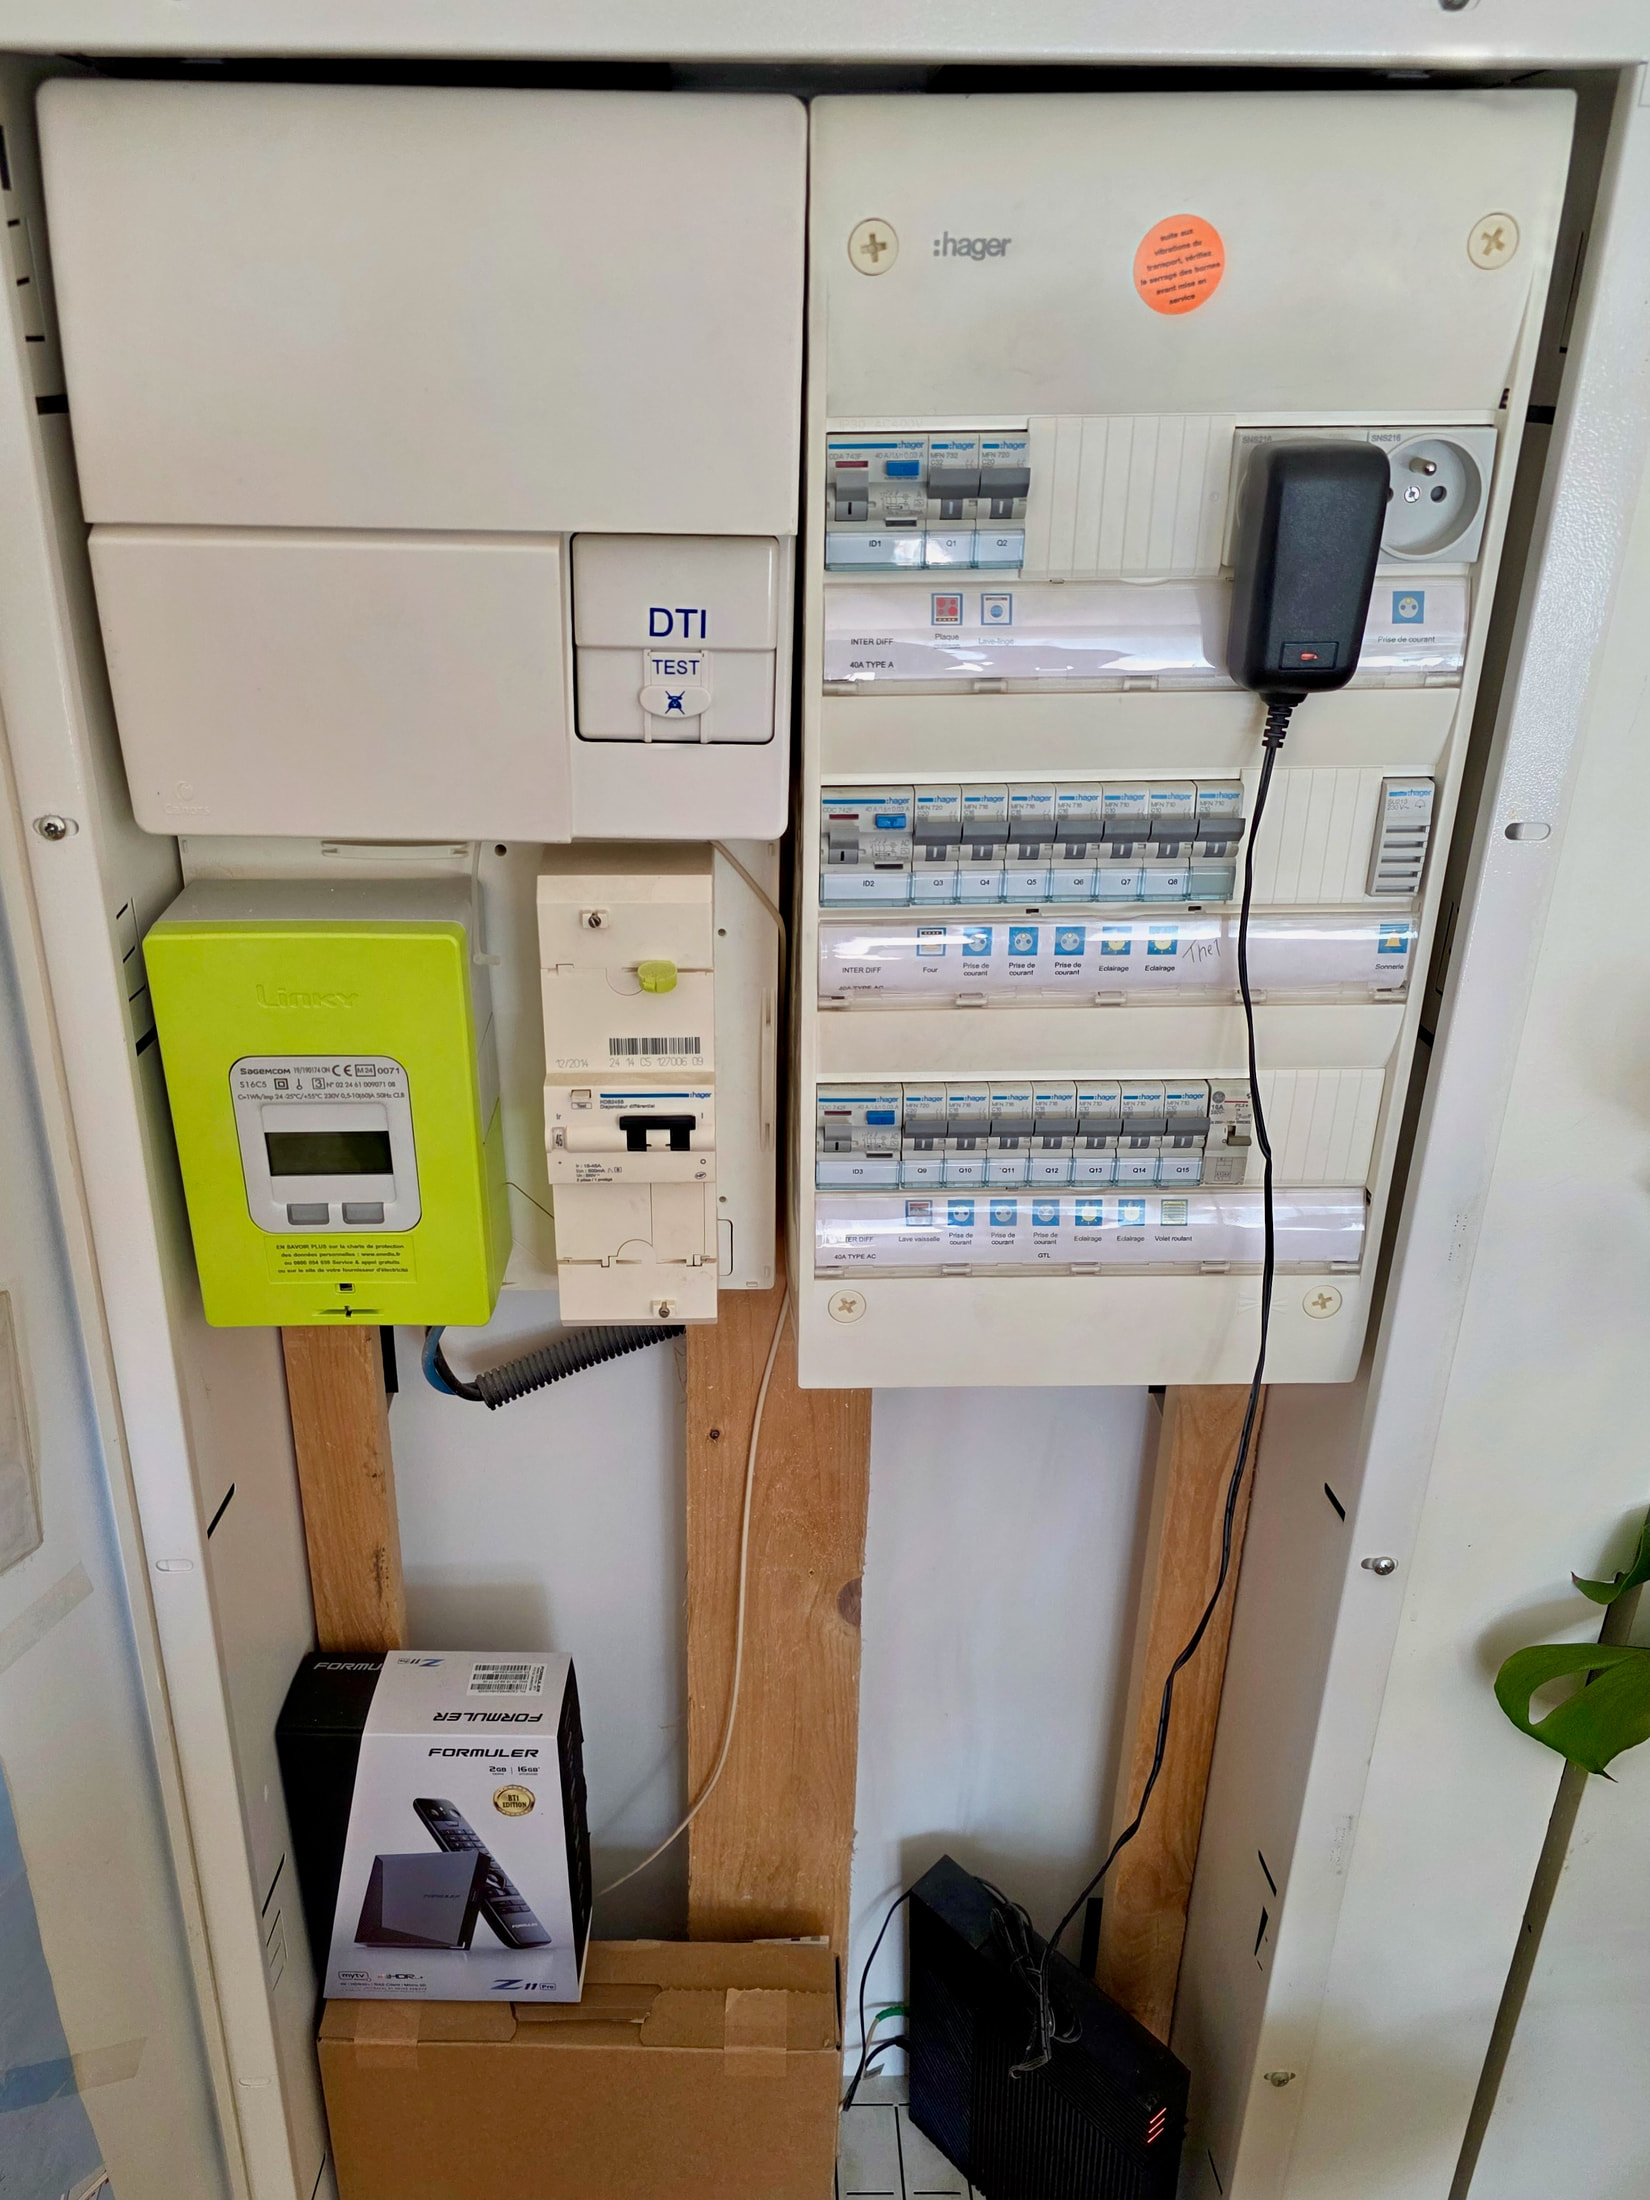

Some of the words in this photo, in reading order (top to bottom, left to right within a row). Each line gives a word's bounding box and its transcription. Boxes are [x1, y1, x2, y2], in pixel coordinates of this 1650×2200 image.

[1169, 293, 1195, 304] service
[946, 540, 957, 548] Q1
[997, 539, 1008, 547] Q2
[649, 607, 707, 639] DTI
[934, 633, 959, 641] Plaque
[1378, 635, 1396, 643] Prise
[1397, 635, 1407, 643] de
[850, 637, 874, 646] INTER
[876, 637, 894, 646] DIFF
[651, 659, 700, 675] TEST
[850, 660, 865, 669] 40A
[866, 660, 886, 669] TYPE
[887, 660, 894, 669] A
[933, 879, 944, 887] Q3
[1120, 878, 1131, 886] Q7
[1167, 878, 1178, 886] Q8
[866, 966, 882, 974] DIFF
[1009, 969, 1034, 977] courant
[555, 1133, 563, 1146] 45
[432, 1712, 544, 1722] FORMULER
[428, 1748, 540, 1758] FORMULER
